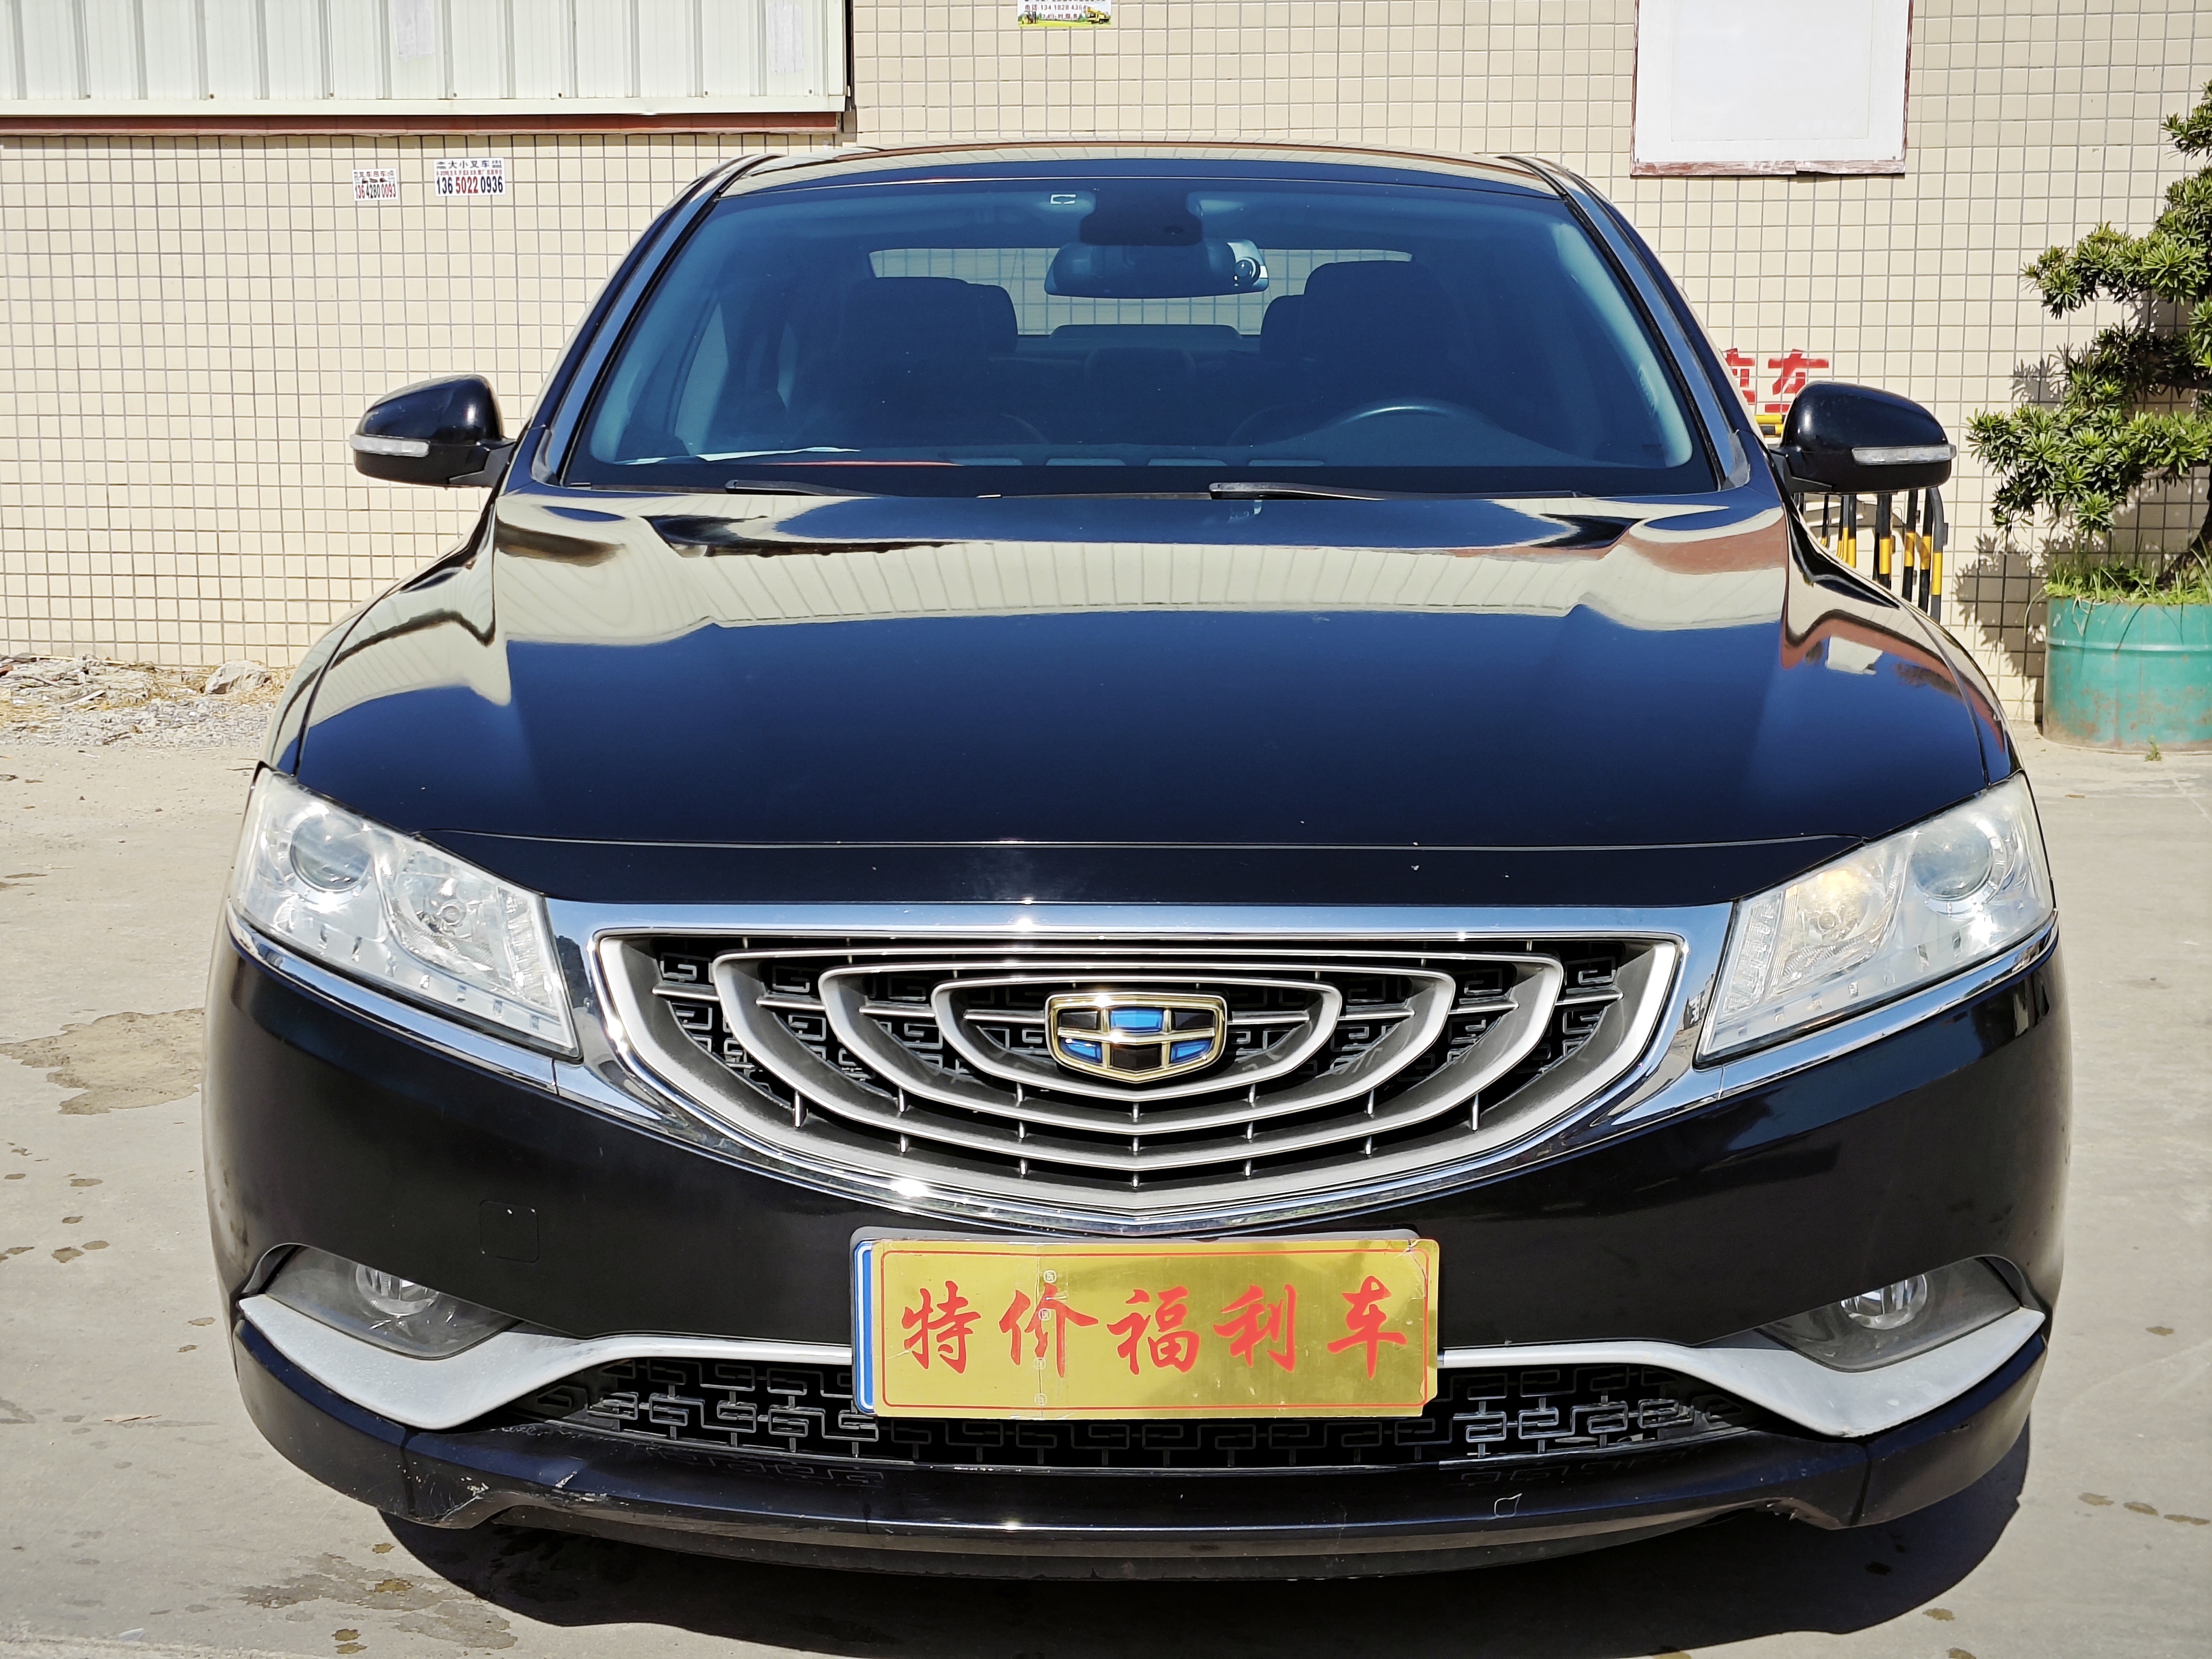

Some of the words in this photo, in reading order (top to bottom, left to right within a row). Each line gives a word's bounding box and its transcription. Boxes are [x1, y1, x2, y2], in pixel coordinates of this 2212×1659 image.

[355, 184, 365, 199] 136
[366, 184, 381, 199] 4280
[381, 183, 396, 198] 0093
[436, 177, 453, 194] 136
[455, 176, 478, 194] 5022
[481, 176, 503, 193] 0936
[900, 1274, 1407, 1379] 特价福利车
